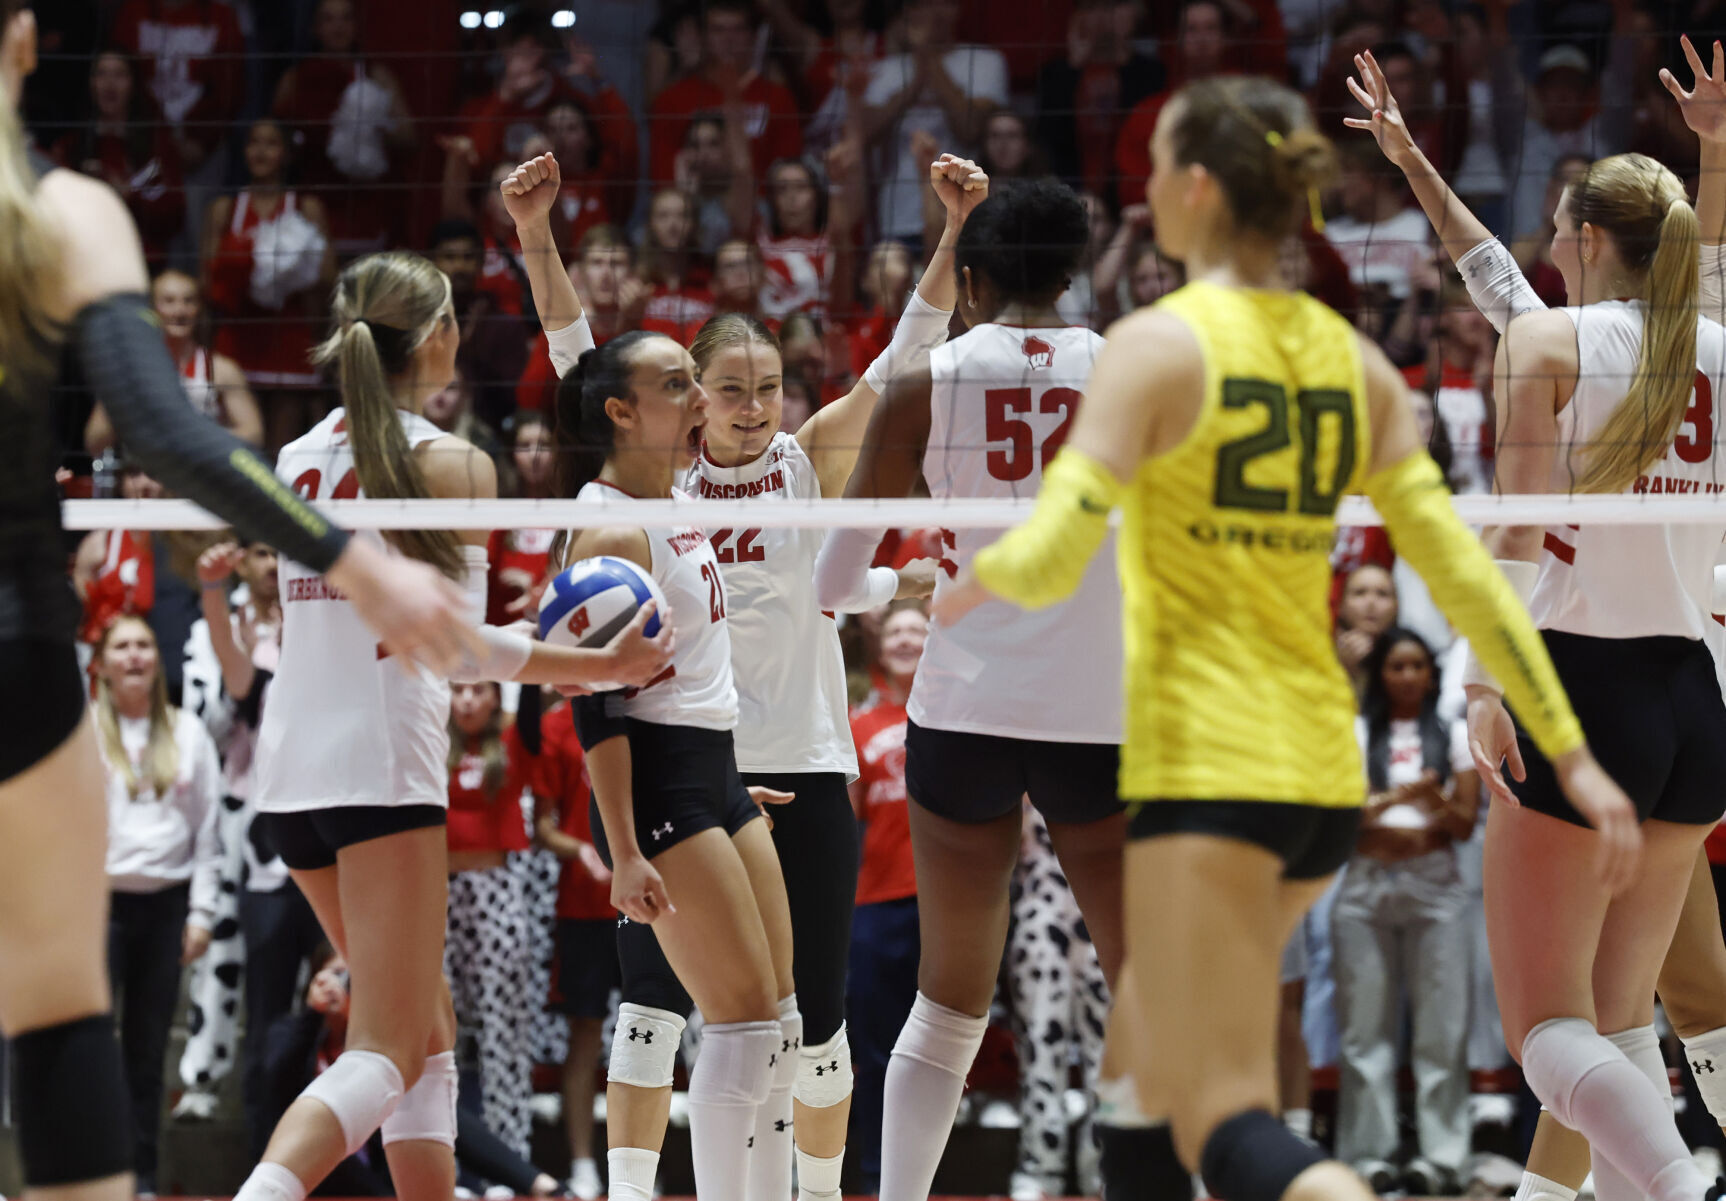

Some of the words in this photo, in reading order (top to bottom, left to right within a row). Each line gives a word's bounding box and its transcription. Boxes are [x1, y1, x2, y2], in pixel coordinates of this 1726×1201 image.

[985, 387, 1085, 481] 52
[1213, 377, 1356, 516] 20
[1658, 369, 1712, 463] 3
[701, 560, 725, 624] 21
[709, 528, 765, 563] 22
